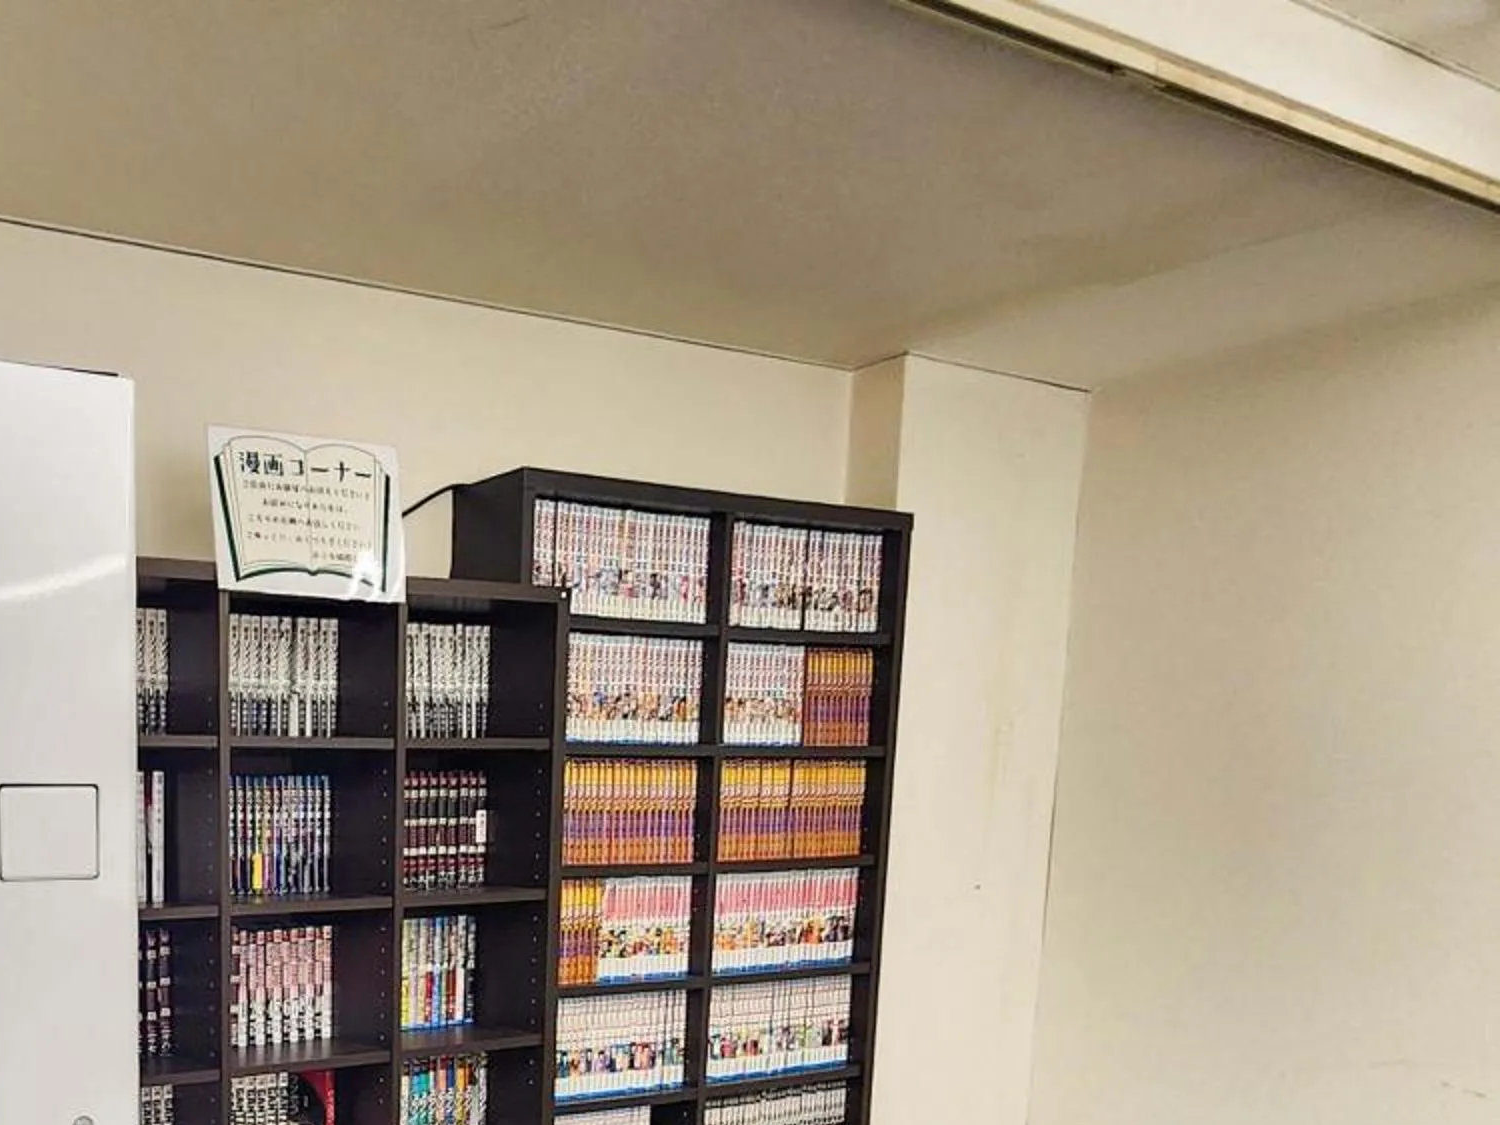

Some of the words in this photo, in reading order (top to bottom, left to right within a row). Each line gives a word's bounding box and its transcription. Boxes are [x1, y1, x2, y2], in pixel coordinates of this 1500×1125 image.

[240, 451, 371, 482] 漫画コーナー
